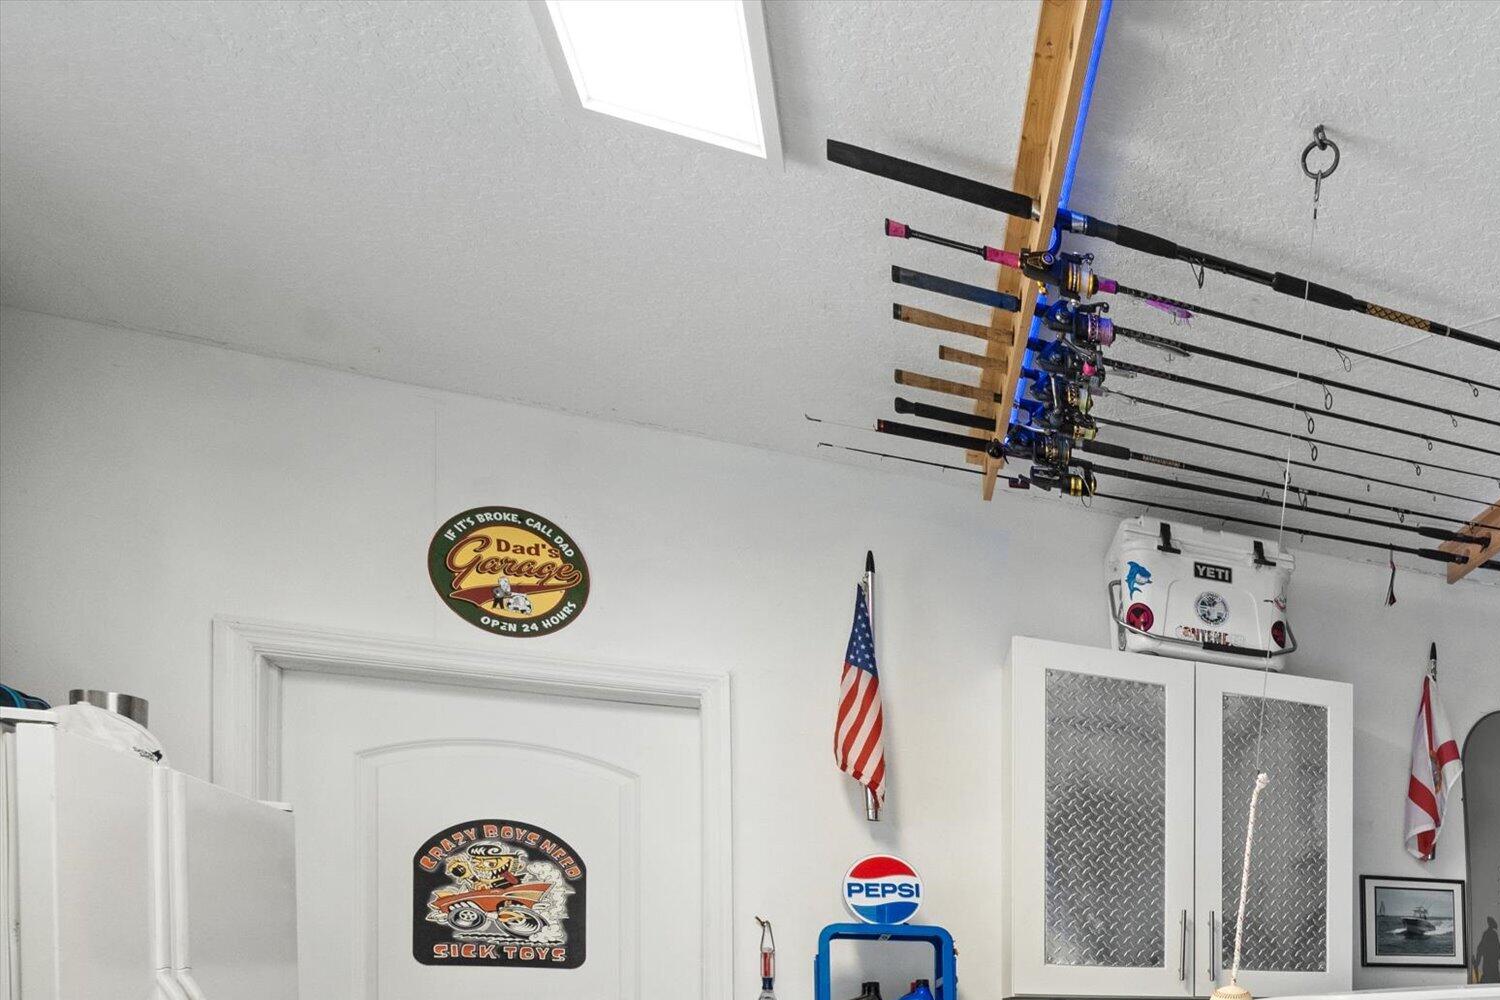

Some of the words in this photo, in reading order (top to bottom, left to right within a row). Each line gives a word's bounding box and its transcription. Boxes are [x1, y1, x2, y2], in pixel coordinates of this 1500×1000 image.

[444, 529, 457, 541] IF
[454, 516, 475, 533] IT'S
[525, 518, 553, 538] CALL
[553, 535, 575, 558] DAD
[496, 538, 560, 558] Dad's
[446, 534, 583, 590] Garage
[1196, 565, 1230, 582] YETI
[480, 615, 518, 633] OPEN
[522, 622, 539, 633] 24
[543, 601, 577, 629] HOURS
[419, 827, 478, 871] CRAZY
[482, 824, 541, 846] BOYS
[540, 838, 583, 880] NEED
[847, 882, 920, 898] PEPSI
[433, 943, 496, 960] SICK
[503, 946, 566, 962] TOYS
